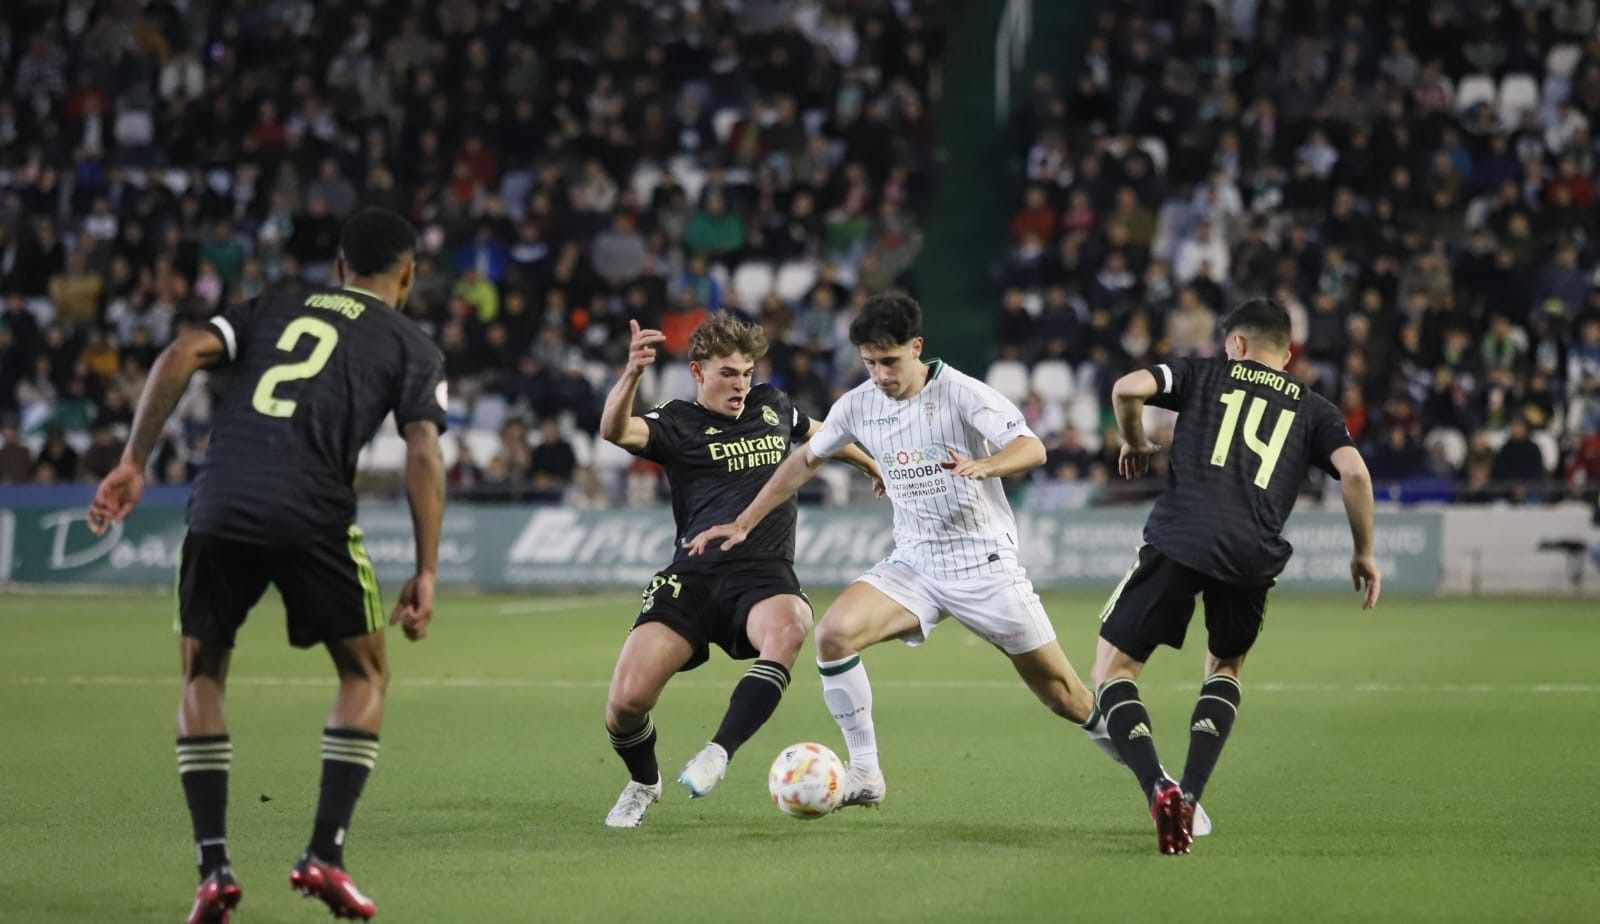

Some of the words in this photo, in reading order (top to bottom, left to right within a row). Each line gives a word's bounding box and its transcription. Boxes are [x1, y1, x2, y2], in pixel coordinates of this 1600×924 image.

[252, 316, 339, 418] 2
[1231, 363, 1286, 391] ÁLVARO
[1285, 383, 1301, 401] M.
[708, 434, 786, 460] Emirates
[1210, 389, 1296, 490] 14
[728, 457, 746, 473] FLY
[748, 450, 783, 469] BETTER
[888, 463, 943, 480] CÓRDOBA
[902, 485, 948, 499] HUMANIDAD
[934, 477, 946, 487] DE
